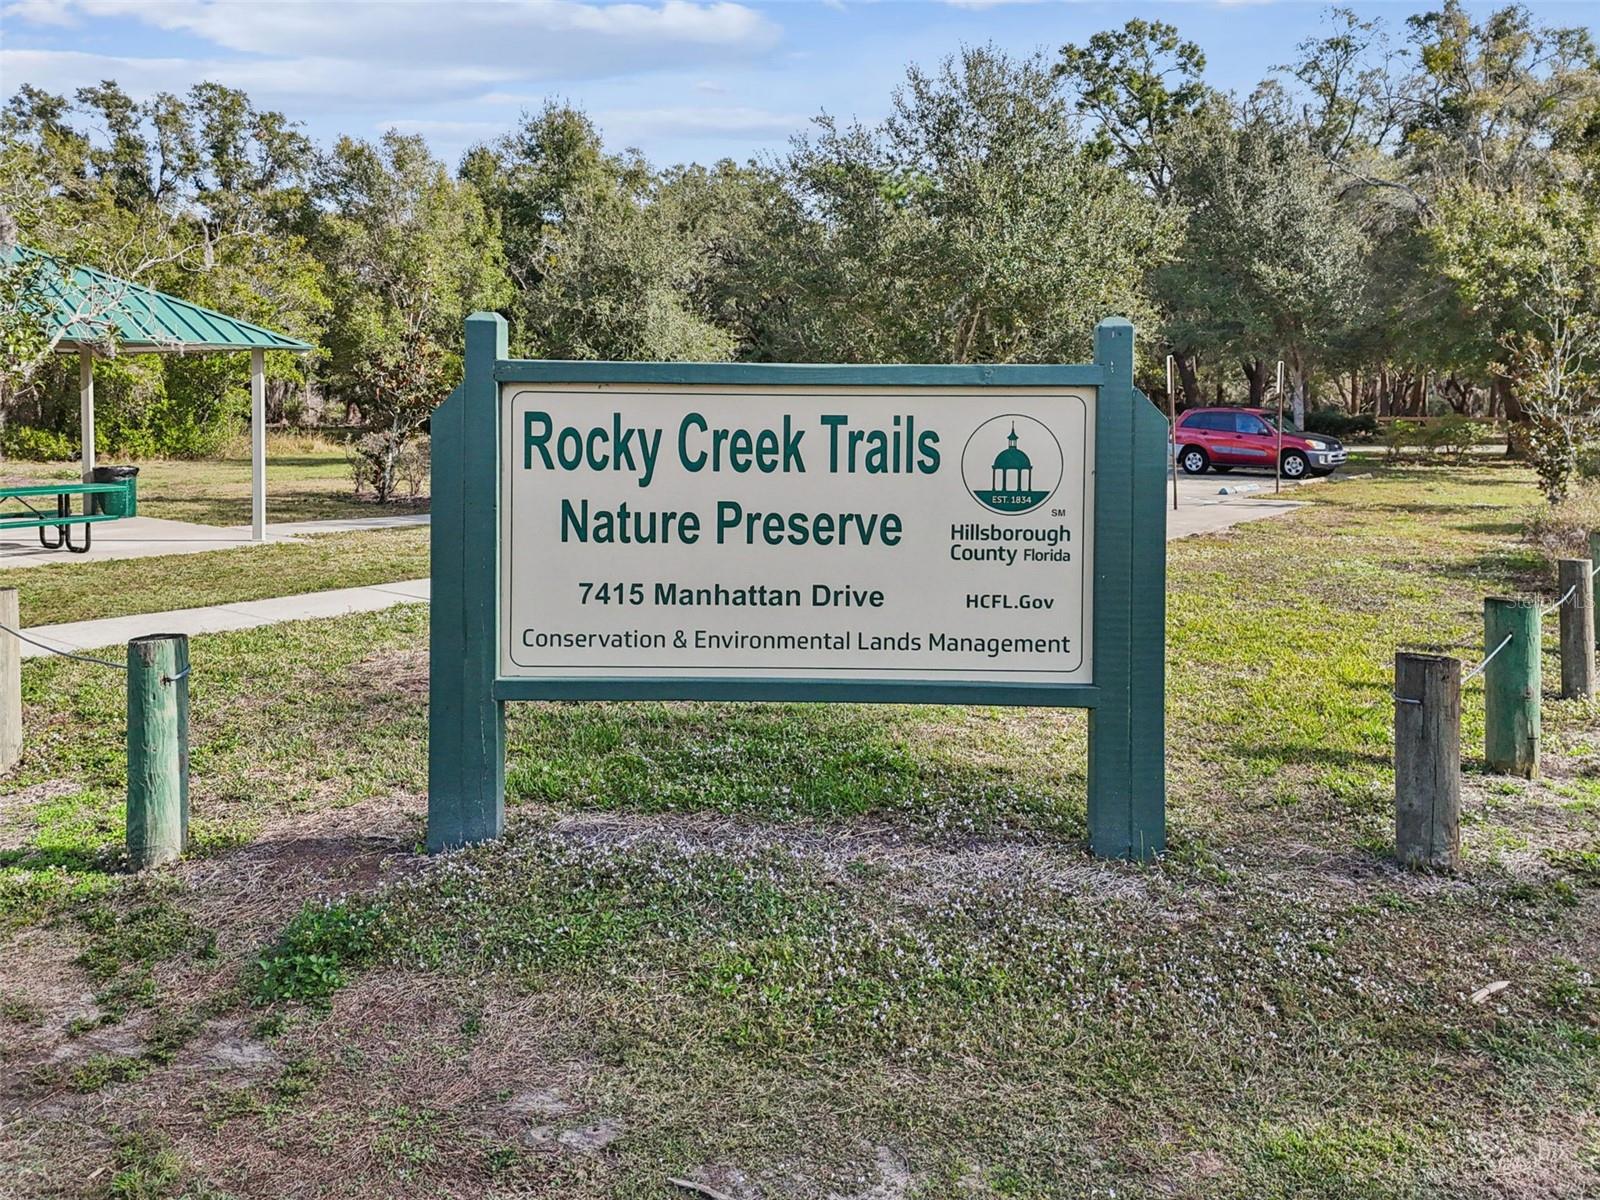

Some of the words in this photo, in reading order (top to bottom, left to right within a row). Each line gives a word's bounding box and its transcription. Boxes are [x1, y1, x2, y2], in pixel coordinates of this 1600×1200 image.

[524, 411, 662, 488] Rocky
[678, 413, 806, 473] Creek
[821, 415, 940, 474] Trails
[992, 496, 1008, 504] EST.
[1011, 496, 1032, 504] 1834
[561, 499, 700, 544] Nature
[717, 501, 902, 546] Preserve
[1052, 509, 1065, 517] SM
[951, 524, 1070, 545] Hillsborough
[950, 544, 1018, 566] County
[1024, 545, 1070, 561] Florida
[579, 583, 644, 605] 7415
[655, 583, 800, 606] Manhattan
[812, 584, 884, 607] Drive
[966, 594, 1054, 609] HCFL.Gov
[523, 629, 665, 648] Conservation
[673, 630, 687, 648] &
[695, 630, 850, 650] Environmental
[858, 632, 921, 651] Lands
[929, 633, 1070, 657] Management
